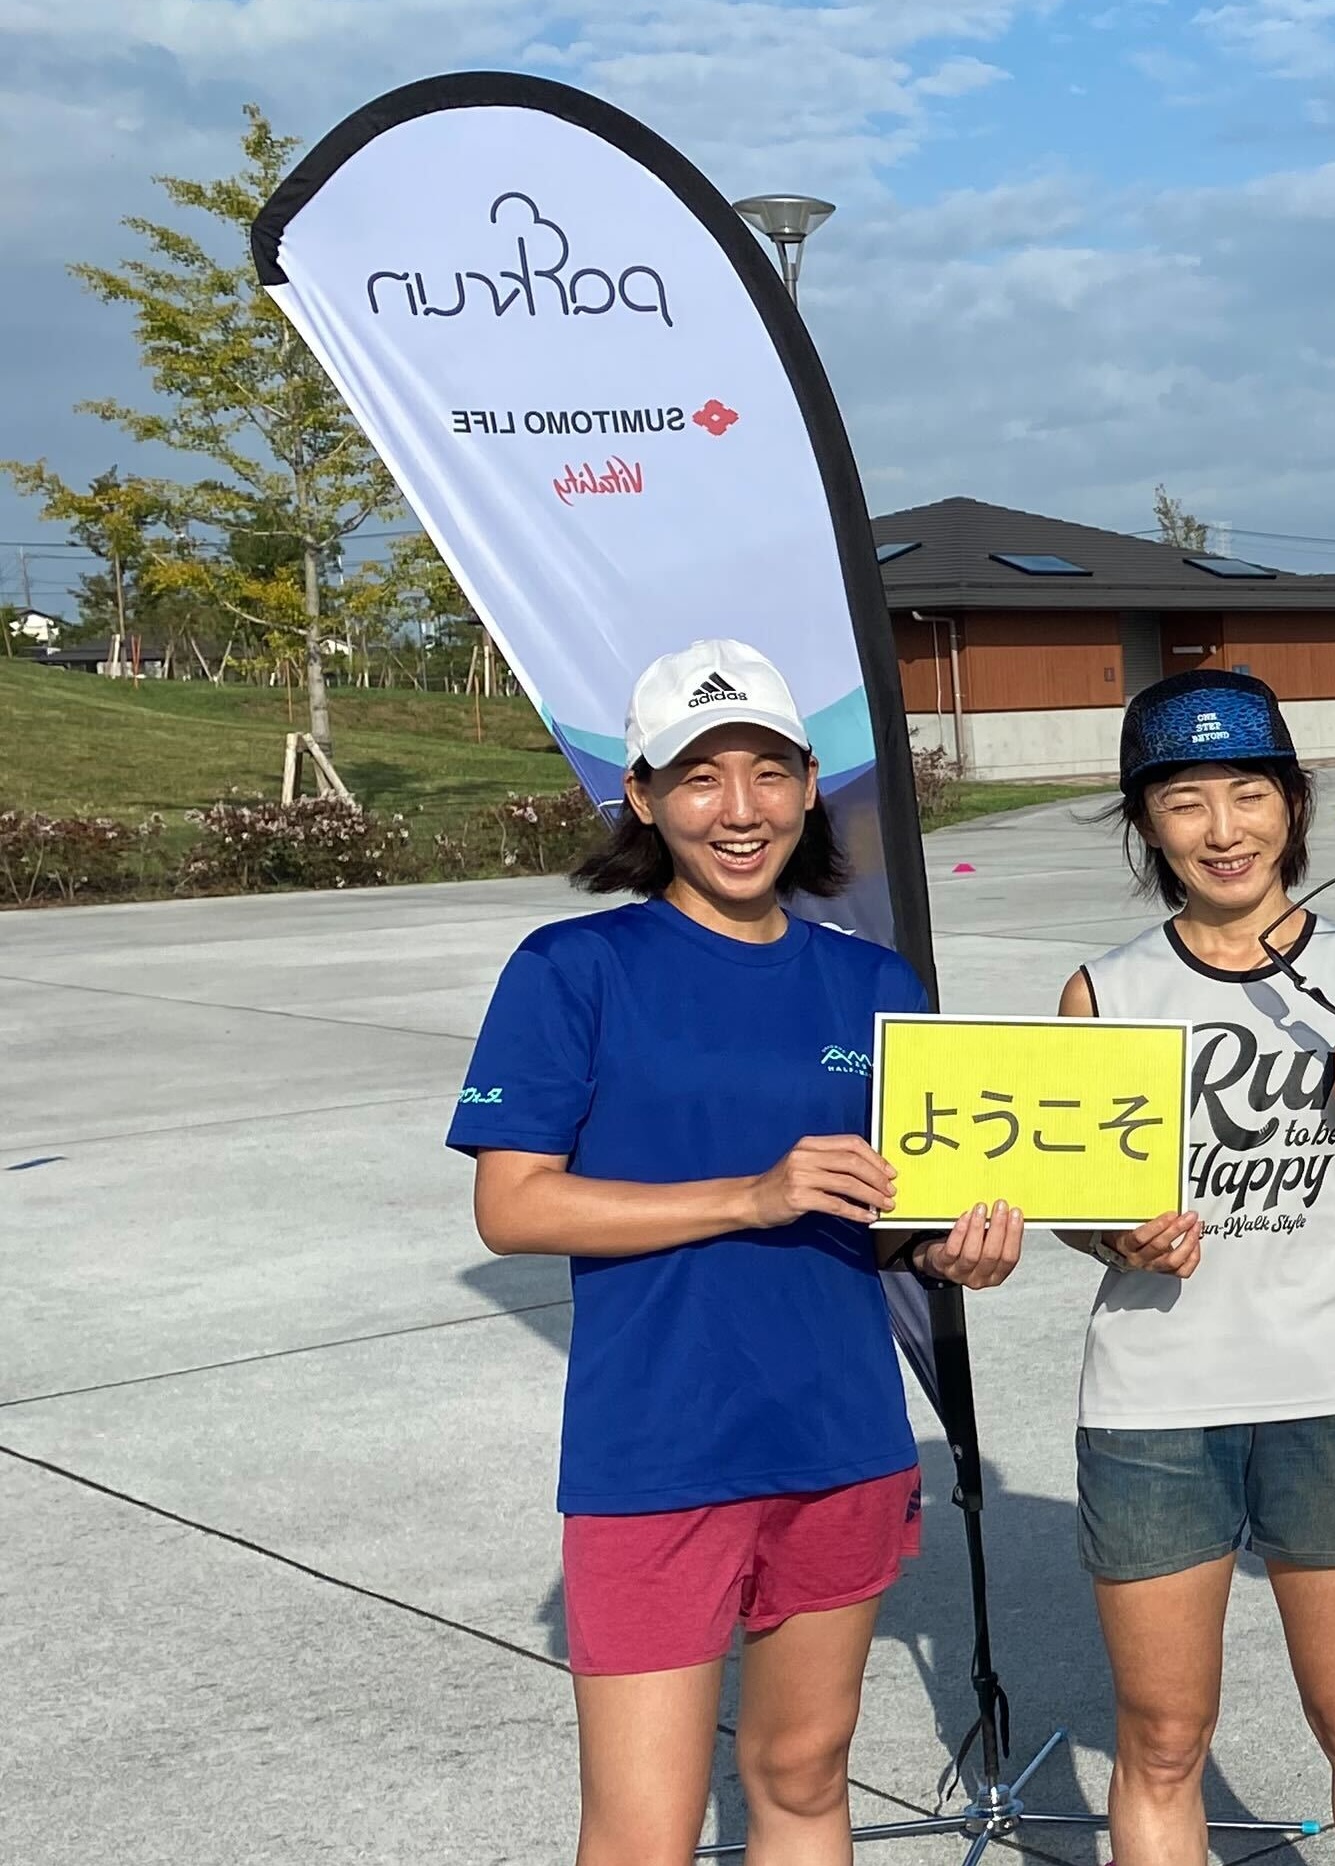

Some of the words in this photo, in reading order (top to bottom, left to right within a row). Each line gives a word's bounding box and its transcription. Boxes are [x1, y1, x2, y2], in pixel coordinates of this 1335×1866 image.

[688, 691, 747, 707] adidas
[1195, 722, 1221, 731] STEP
[1191, 731, 1230, 743] BEYOND
[899, 1090, 1163, 1161] ようこそ
[1190, 1143, 1335, 1214] Happy
[1270, 1212, 1308, 1236] Style
